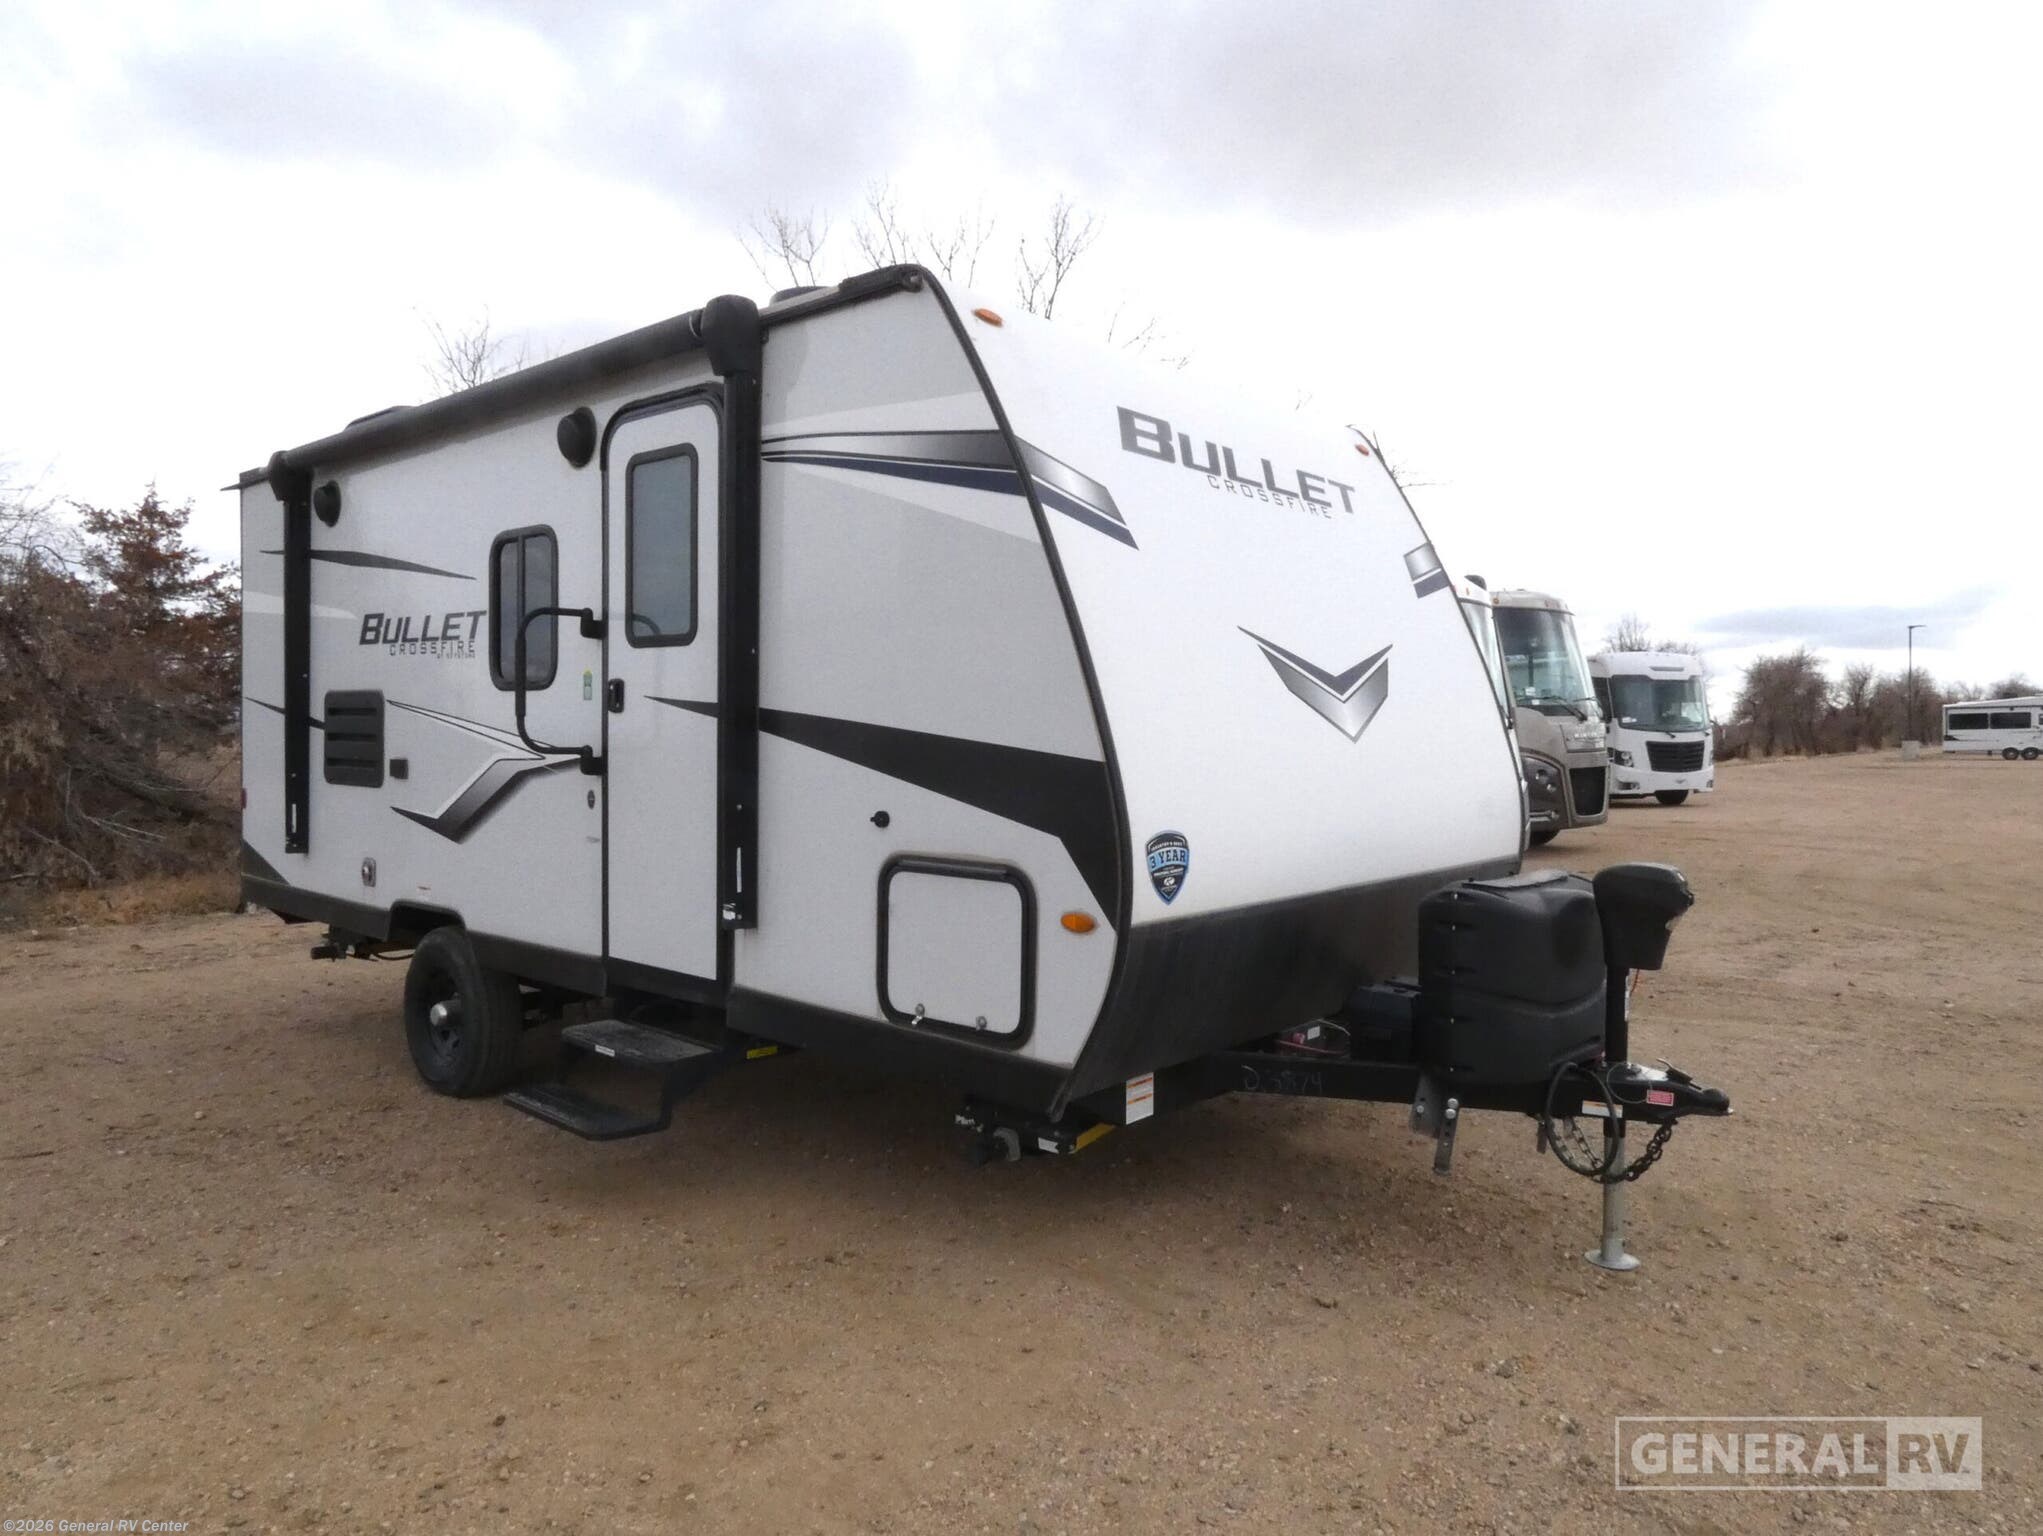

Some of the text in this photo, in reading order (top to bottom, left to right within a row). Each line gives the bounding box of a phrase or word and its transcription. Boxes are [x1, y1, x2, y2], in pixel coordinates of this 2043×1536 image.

[1207, 475, 1332, 519] CROSSFIRE
[389, 640, 475, 656] CROSSFIRE
[1149, 848, 1187, 869] 3 YEAR
